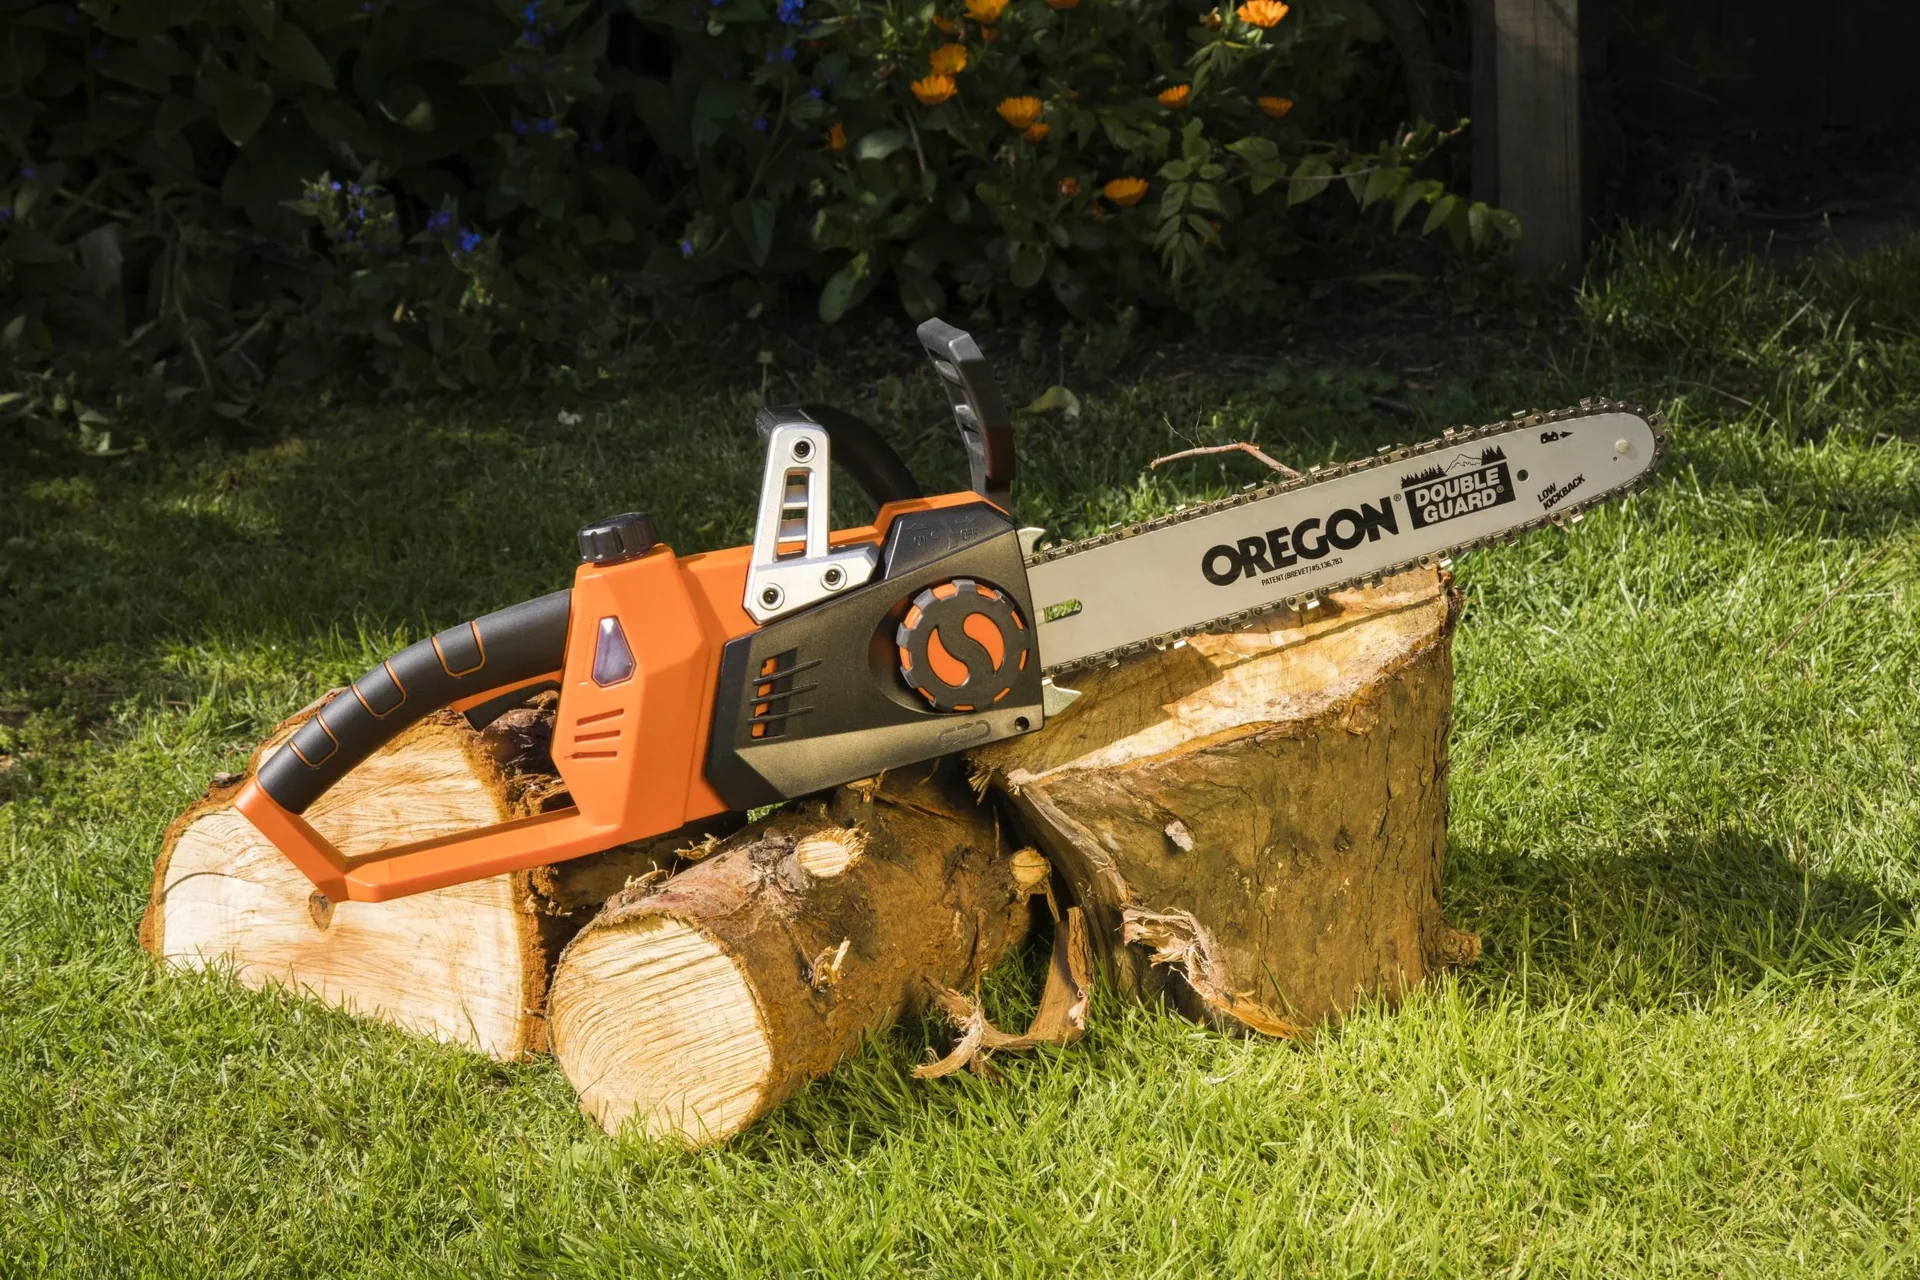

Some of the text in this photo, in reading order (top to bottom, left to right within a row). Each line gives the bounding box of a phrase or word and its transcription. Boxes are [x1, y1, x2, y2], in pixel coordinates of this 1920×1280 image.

[1414, 468, 1500, 507] DOUBLE
[1537, 482, 1557, 503] LOW
[1542, 474, 1586, 511] KICKBACK
[1261, 574, 1285, 586] PATENT
[1284, 566, 1312, 581] (BREVET)
